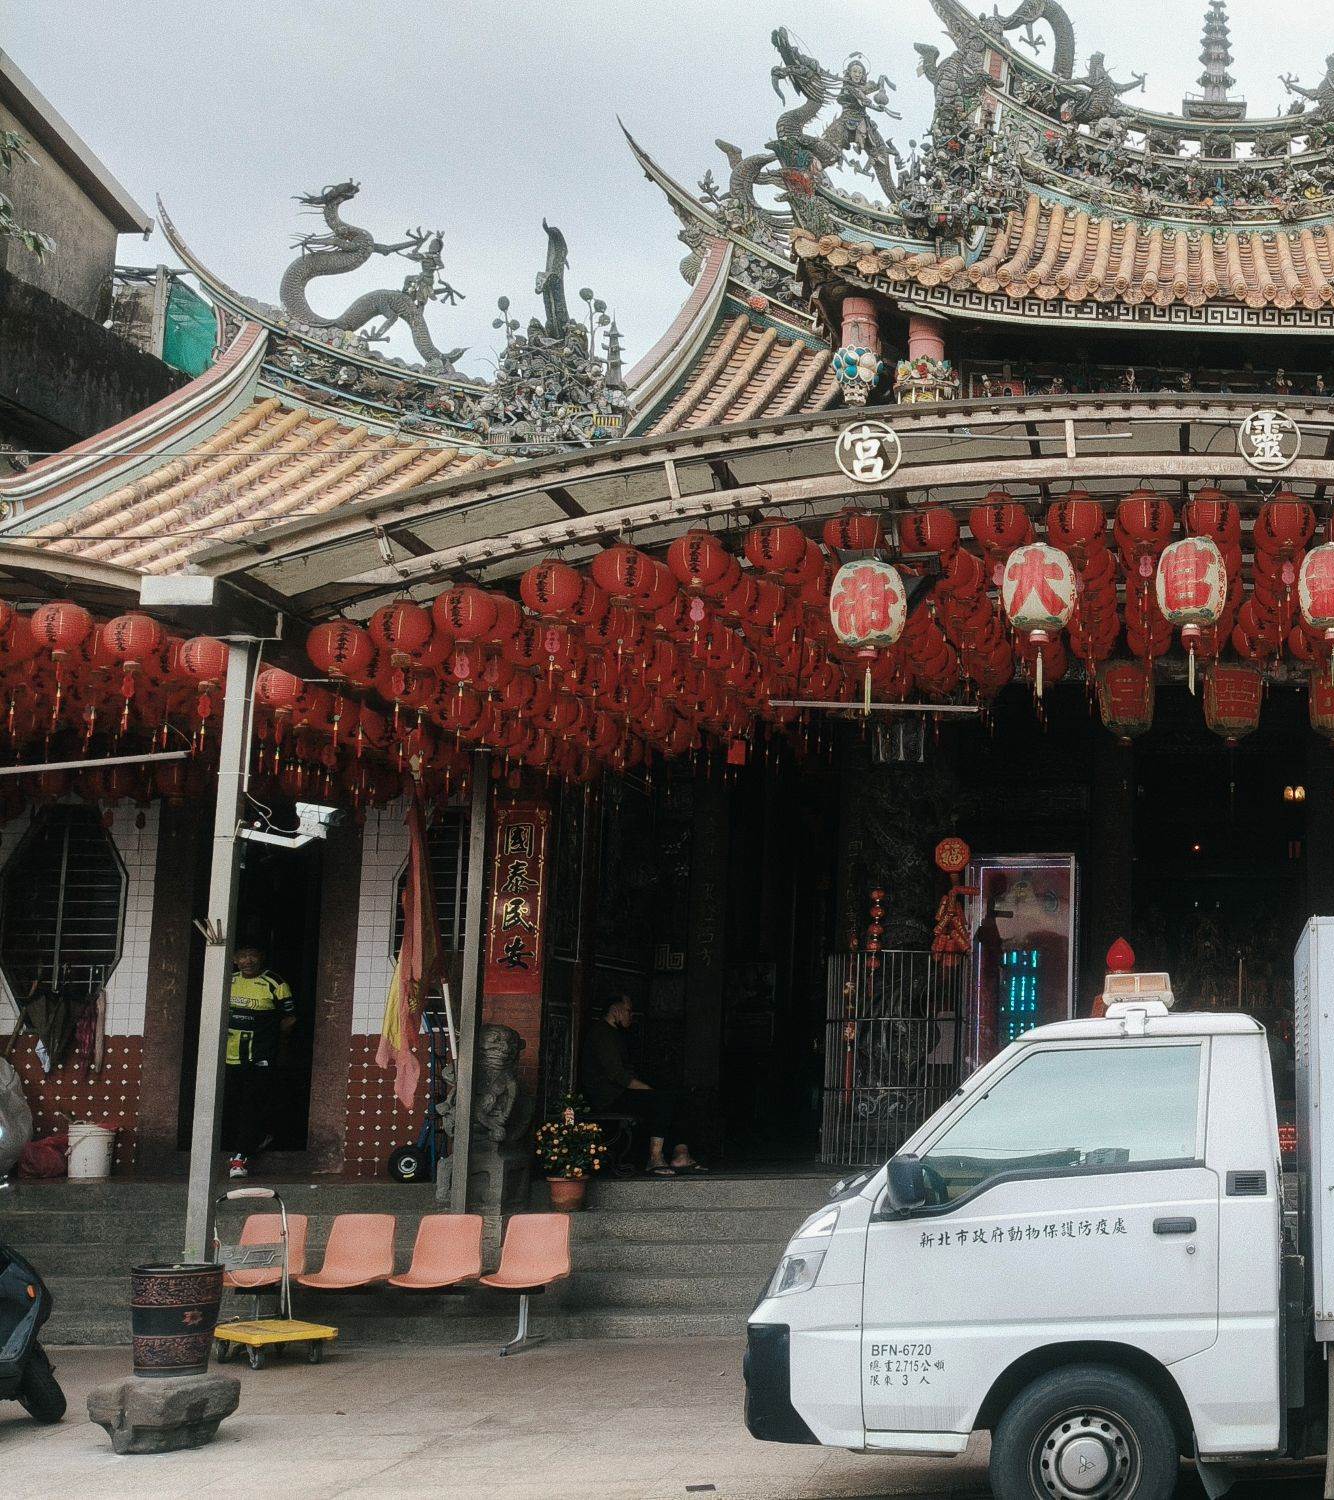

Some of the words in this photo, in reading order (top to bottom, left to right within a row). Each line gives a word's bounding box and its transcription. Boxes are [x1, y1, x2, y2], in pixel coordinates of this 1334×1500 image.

[842, 424, 895, 480] 宮
[1244, 411, 1295, 468] 靈
[1006, 548, 1068, 618] 大
[497, 822, 538, 970] 國泰民安
[919, 1217, 1128, 1249] 新北市政府動物保護防疫處
[871, 1344, 932, 1357] BFN-6720
